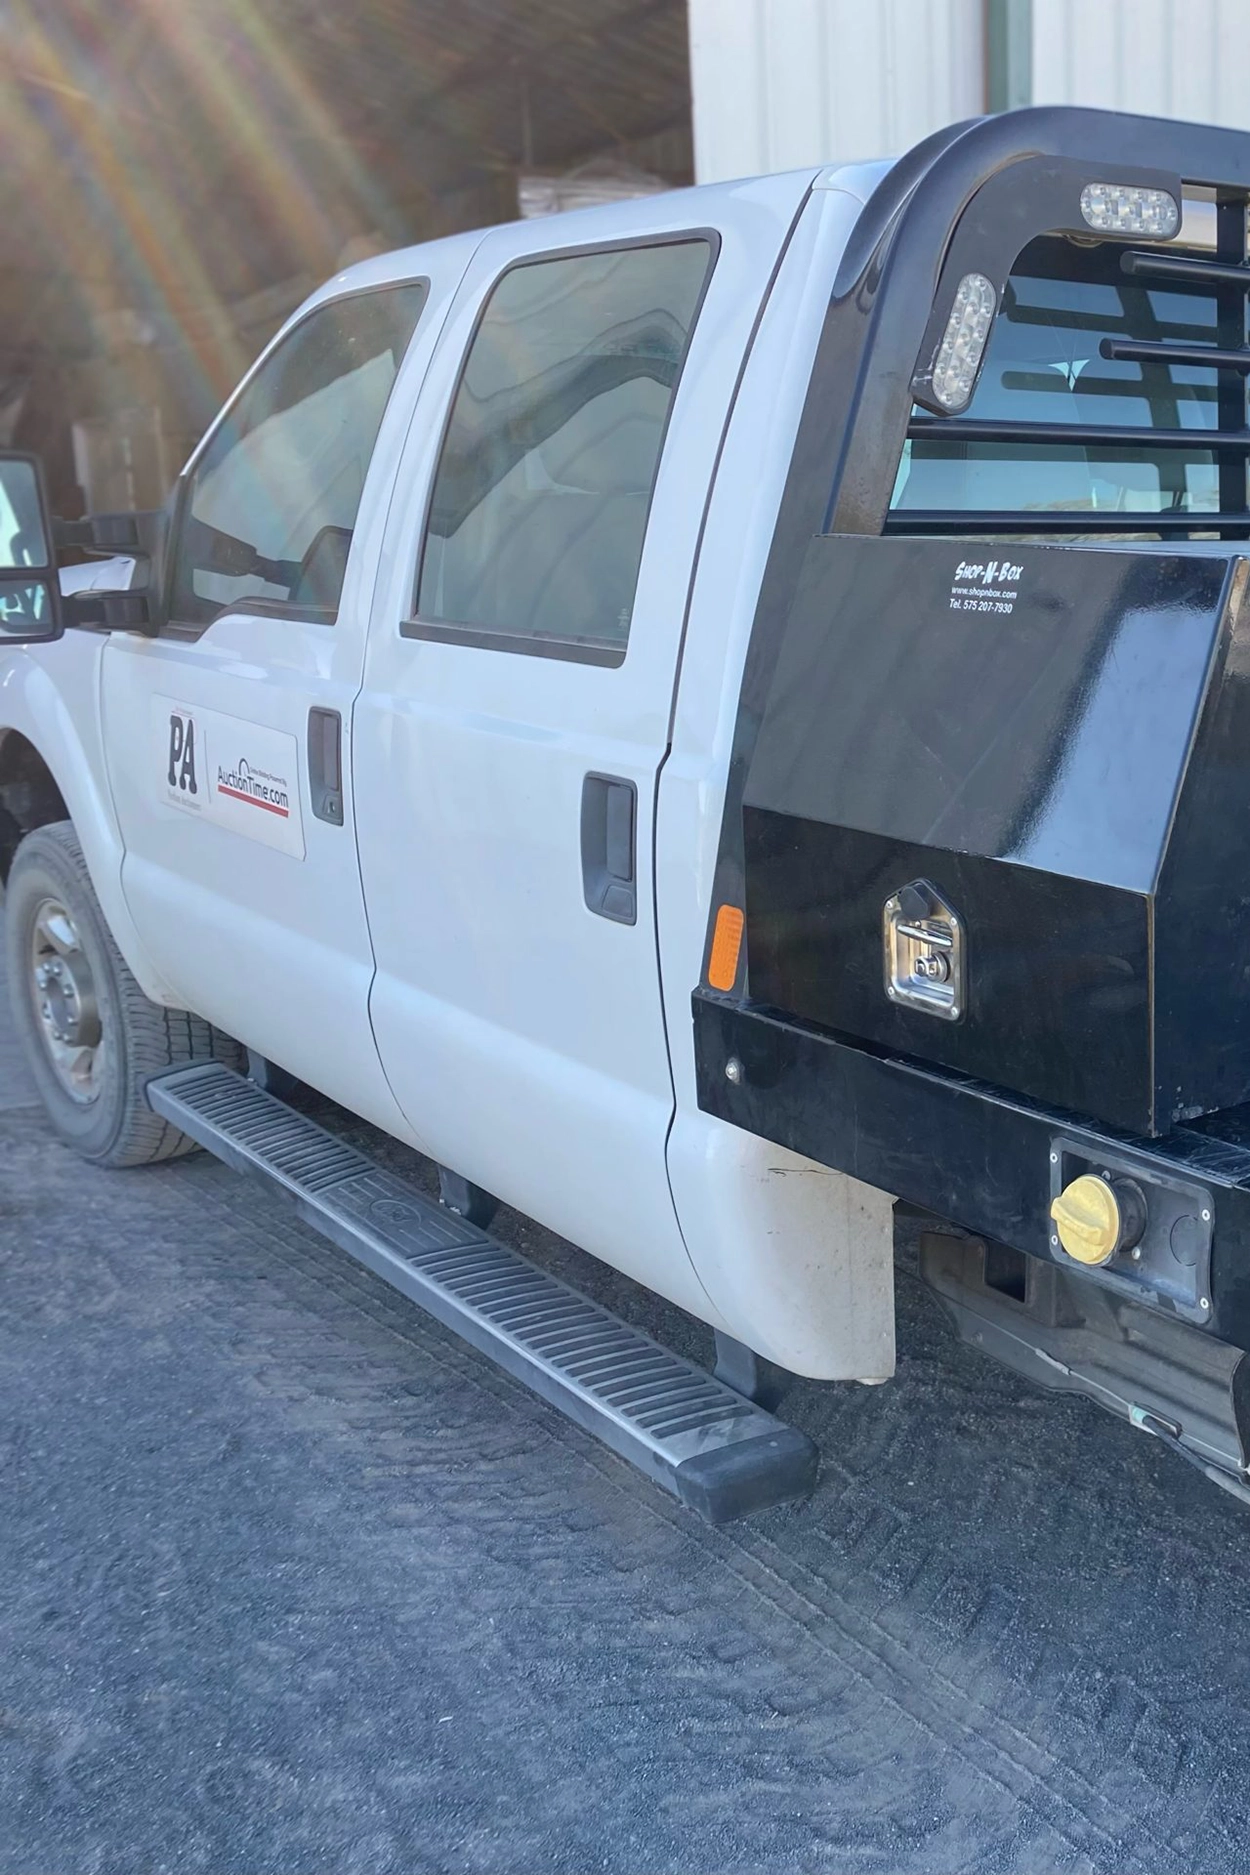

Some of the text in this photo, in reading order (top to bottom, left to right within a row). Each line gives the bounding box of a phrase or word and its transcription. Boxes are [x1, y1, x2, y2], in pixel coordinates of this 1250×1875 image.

[949, 599, 1013, 614] Tel. 575 207-7930
[951, 587, 1017, 599] www.shopnbox.com
[168, 715, 197, 794] PA
[218, 765, 289, 808] AuctionTime.com
